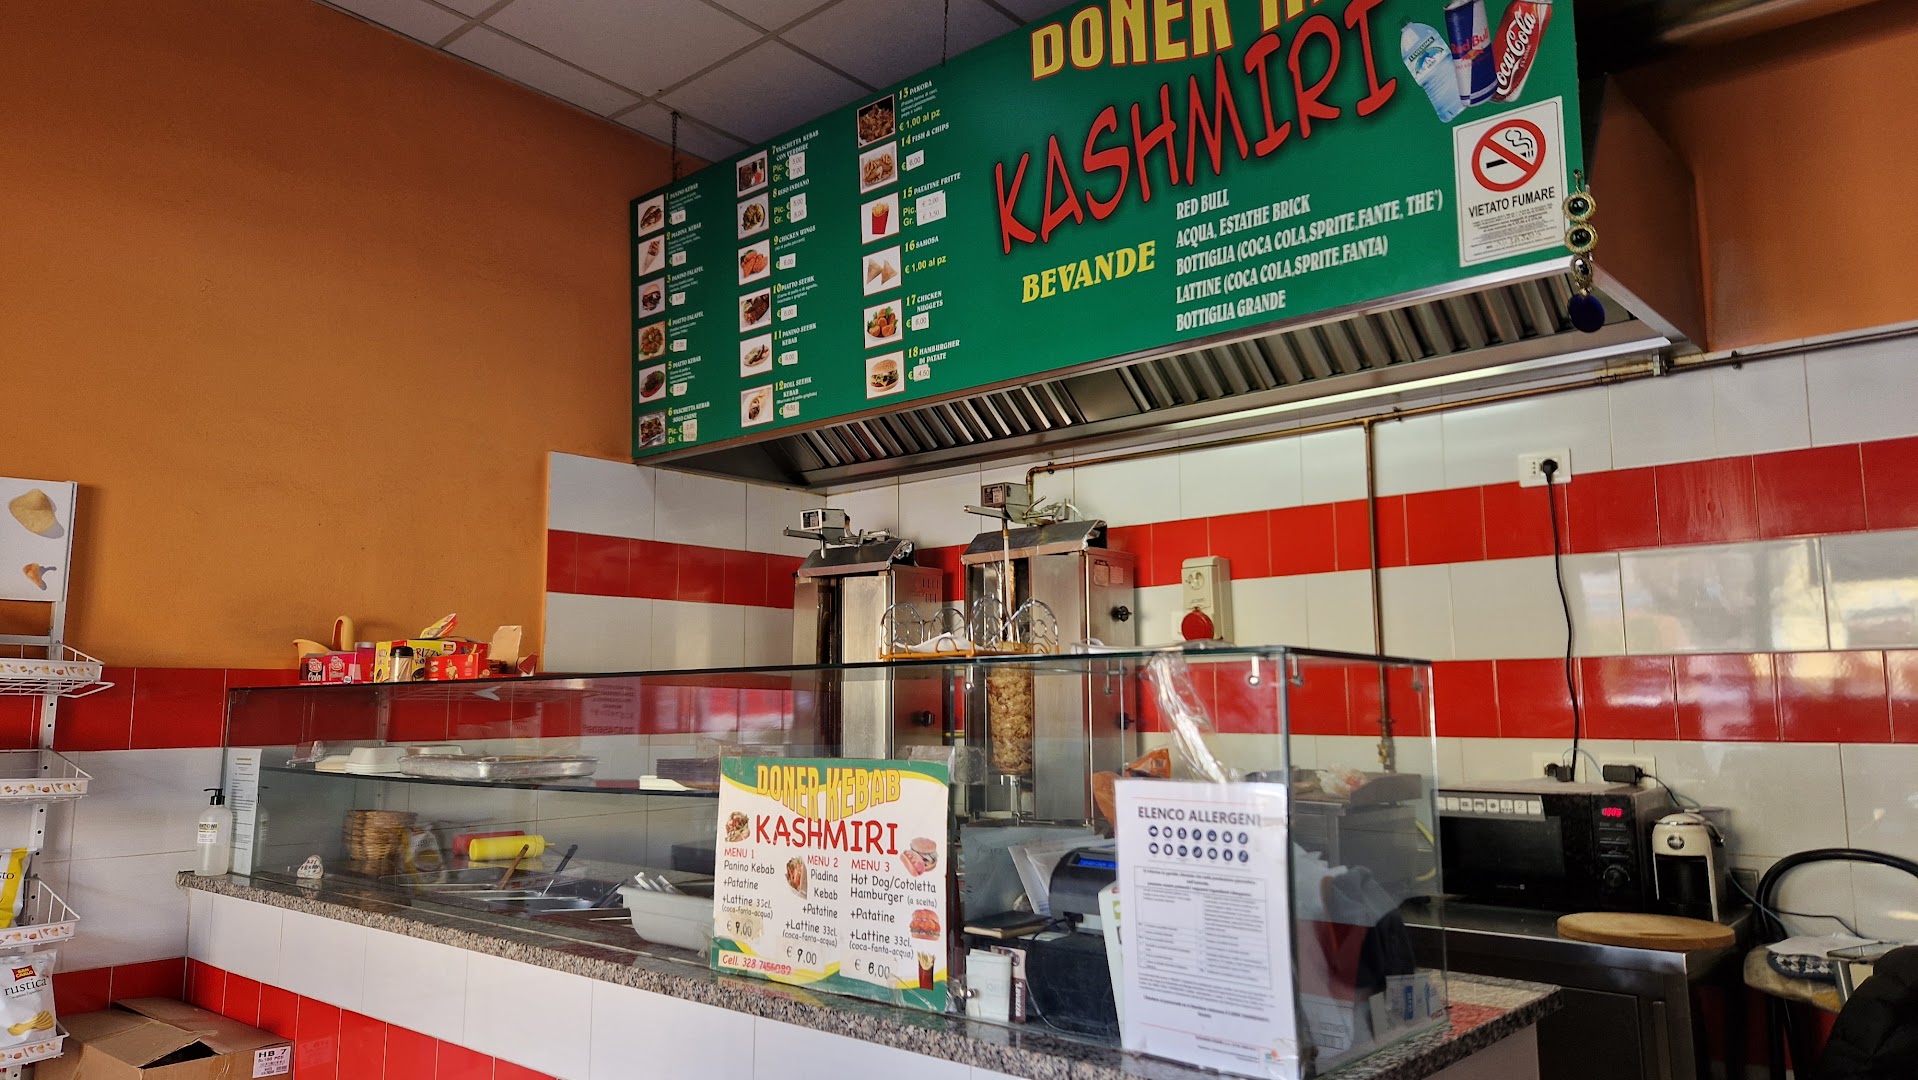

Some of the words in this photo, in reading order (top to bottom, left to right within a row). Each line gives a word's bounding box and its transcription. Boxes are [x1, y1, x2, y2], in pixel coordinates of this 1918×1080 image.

[1030, 0, 1236, 79] DONER
[1451, 42, 1470, 54] Red
[1472, 27, 1489, 47] Bull
[899, 87, 909, 100] 13
[909, 80, 932, 95] PAKORA
[899, 122, 904, 131] €
[906, 115, 920, 129] 1,00
[922, 112, 929, 122] al
[931, 109, 940, 120] pz
[995, 0, 1397, 254] KASHMIRI
[901, 134, 911, 147] 14
[912, 131, 925, 143] FISH
[926, 130, 931, 138] &
[931, 122, 949, 135] CHIPS
[772, 145, 776, 155] 7
[802, 130, 819, 142] KEBAB
[776, 152, 787, 161] CON
[772, 165, 784, 173] Pic.
[773, 174, 782, 182] Gr.
[903, 186, 913, 199] 15
[913, 180, 940, 195] PATATINE
[940, 172, 961, 185] FRITTE
[773, 188, 777, 198] 8
[789, 178, 810, 192] INDIANO
[1176, 198, 1199, 220] RED
[1201, 189, 1229, 213] BULL
[1469, 198, 1509, 217] VIETATO
[1512, 186, 1555, 207] FUMARE
[774, 206, 785, 215] Pic.
[903, 207, 917, 216] Pic.
[774, 216, 783, 224] Gr.
[903, 218, 914, 226] Gr.
[1176, 222, 1217, 248] ACQUA,
[1219, 205, 1270, 236] ESTATHE
[1272, 194, 1311, 221] BRICK
[666, 232, 670, 240] 2
[774, 235, 778, 245] 9
[778, 229, 799, 243] CHICKEN
[800, 225, 816, 236] WINGS
[905, 240, 915, 252] 16
[916, 235, 939, 249] SAMOSA
[1176, 245, 1236, 276] BOTTIGLIA
[1237, 235, 1273, 263] (COCA
[905, 265, 910, 274] €
[911, 260, 927, 272] 1,00
[928, 257, 935, 267] al
[936, 255, 947, 266] pz
[1022, 240, 1156, 303] BEVANDE
[666, 275, 670, 283] 3
[773, 283, 781, 294] 10
[781, 279, 799, 291] PIATTO
[1176, 276, 1222, 304] LATTINE
[1223, 267, 1259, 294] (COCA
[906, 294, 917, 306] 17
[917, 290, 942, 303] CHICKEN
[916, 300, 943, 312] NUGGETS
[1176, 302, 1236, 331] BOTTIGLIA
[1237, 290, 1286, 318] GRANDE
[668, 319, 672, 327] 4
[774, 330, 782, 340] 11
[782, 327, 800, 338] PANINO
[782, 337, 798, 346] KEBAB
[908, 346, 919, 358] 18
[919, 339, 960, 355] HAMBURGHER
[668, 361, 672, 370] 5
[688, 356, 701, 365] KEBAB
[926, 352, 947, 363] PATATE
[775, 380, 784, 391] 12
[784, 381, 795, 390] ROLL
[783, 389, 799, 398] KEBAB
[668, 407, 672, 416] 6
[696, 401, 710, 411] KEBAB
[668, 436, 676, 444] Gr.
[308, 671, 321, 682] Cola
[757, 764, 819, 823] DONER
[826, 767, 901, 823] KEBAB
[1138, 806, 1185, 820] ELENCO
[1188, 810, 1261, 826] ALLERGENI
[756, 814, 899, 855] KASHMIRI
[724, 848, 748, 858] MENU
[751, 849, 754, 859] 1
[724, 860, 748, 872] Panino
[751, 861, 775, 874] Kebab
[807, 855, 830, 867] MENU
[833, 857, 838, 868] 2
[851, 859, 881, 872] MENU
[884, 861, 890, 872] 3
[810, 868, 838, 883] Piadina
[851, 873, 868, 885] Hot
[872, 875, 936, 893] Dog/Cotoletta
[723, 877, 758, 890] +Patatine
[722, 894, 753, 907] +Lattine
[813, 887, 838, 900] Kebab
[850, 886, 904, 906] Hamburger
[907, 895, 914, 906] (a
[916, 898, 938, 909] scelta)
[722, 904, 773, 920] (coca-fanta-acqua)
[802, 903, 838, 918] +Patatine
[850, 908, 895, 923] +Patatine
[727, 920, 732, 932] €
[785, 919, 820, 933] +Lattine
[822, 925, 837, 937] 33cl.
[782, 929, 838, 948] (coca-fanta-acqua)
[850, 929, 890, 944] +Lattine
[894, 935, 912, 948] 33cl.
[786, 945, 792, 958] €
[849, 940, 914, 960] (coca-fanta-acqua)
[722, 954, 739, 966] Cell.
[742, 956, 756, 969] 328
[854, 958, 861, 971] €
[4, 977, 48, 996] rustica
[258, 1050, 275, 1058] HB
